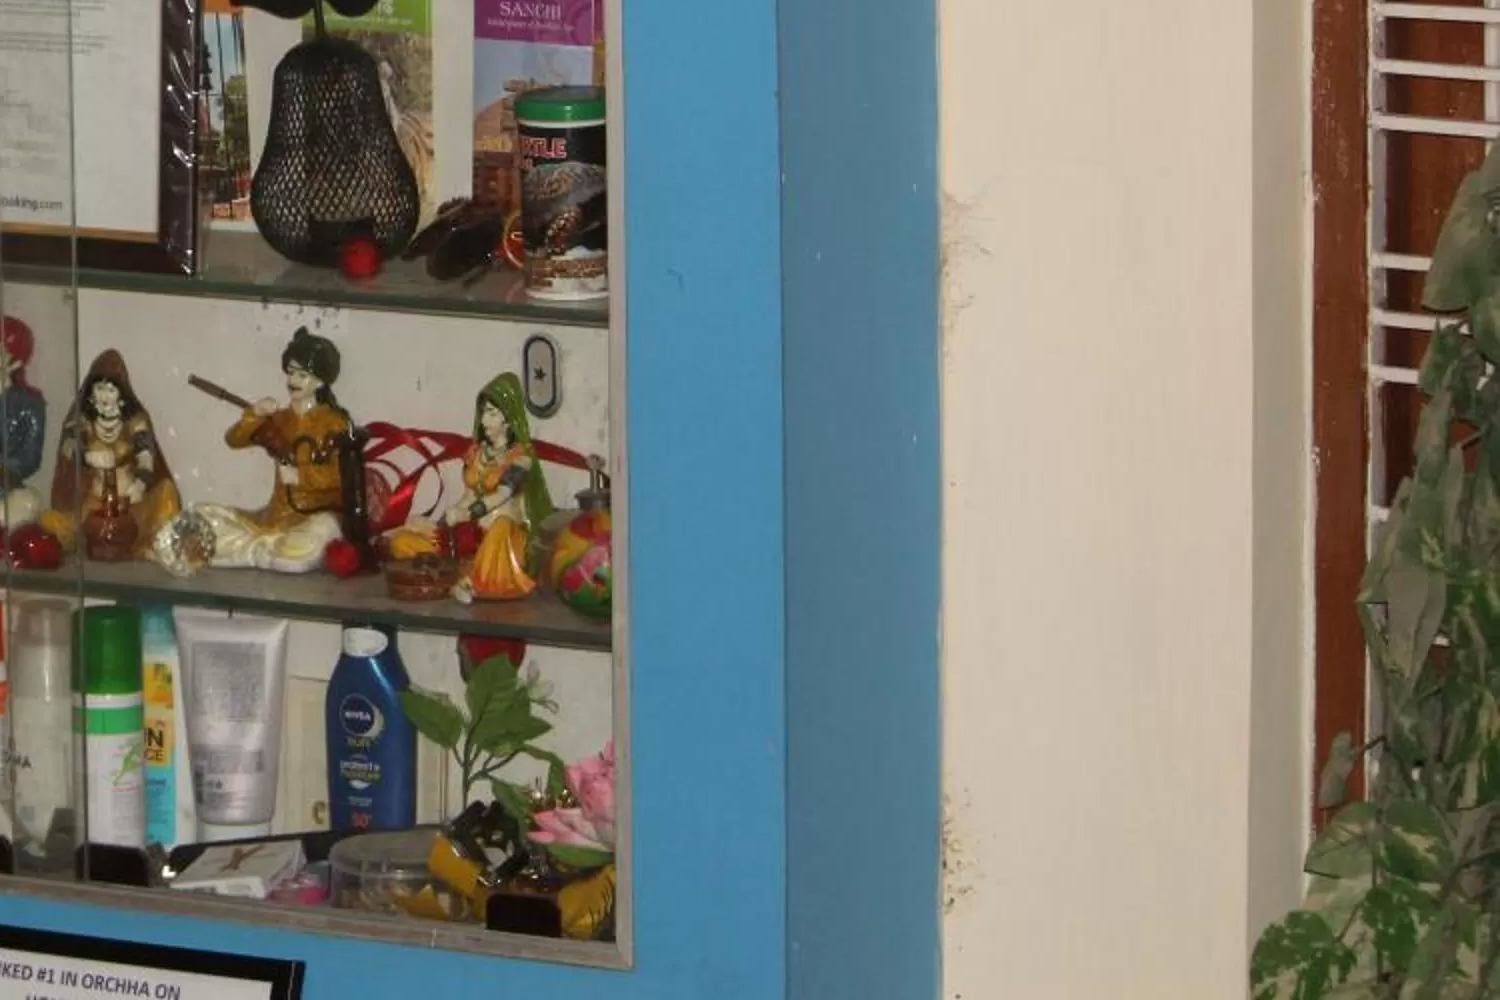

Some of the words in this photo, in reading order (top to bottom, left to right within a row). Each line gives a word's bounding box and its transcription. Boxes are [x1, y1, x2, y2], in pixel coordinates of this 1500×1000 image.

[499, 0, 562, 22] SANCHI
[37, 967, 55, 985] #1
[60, 969, 78, 988] IN
[81, 973, 151, 998] ORCHHA
[154, 983, 182, 1000] ON
